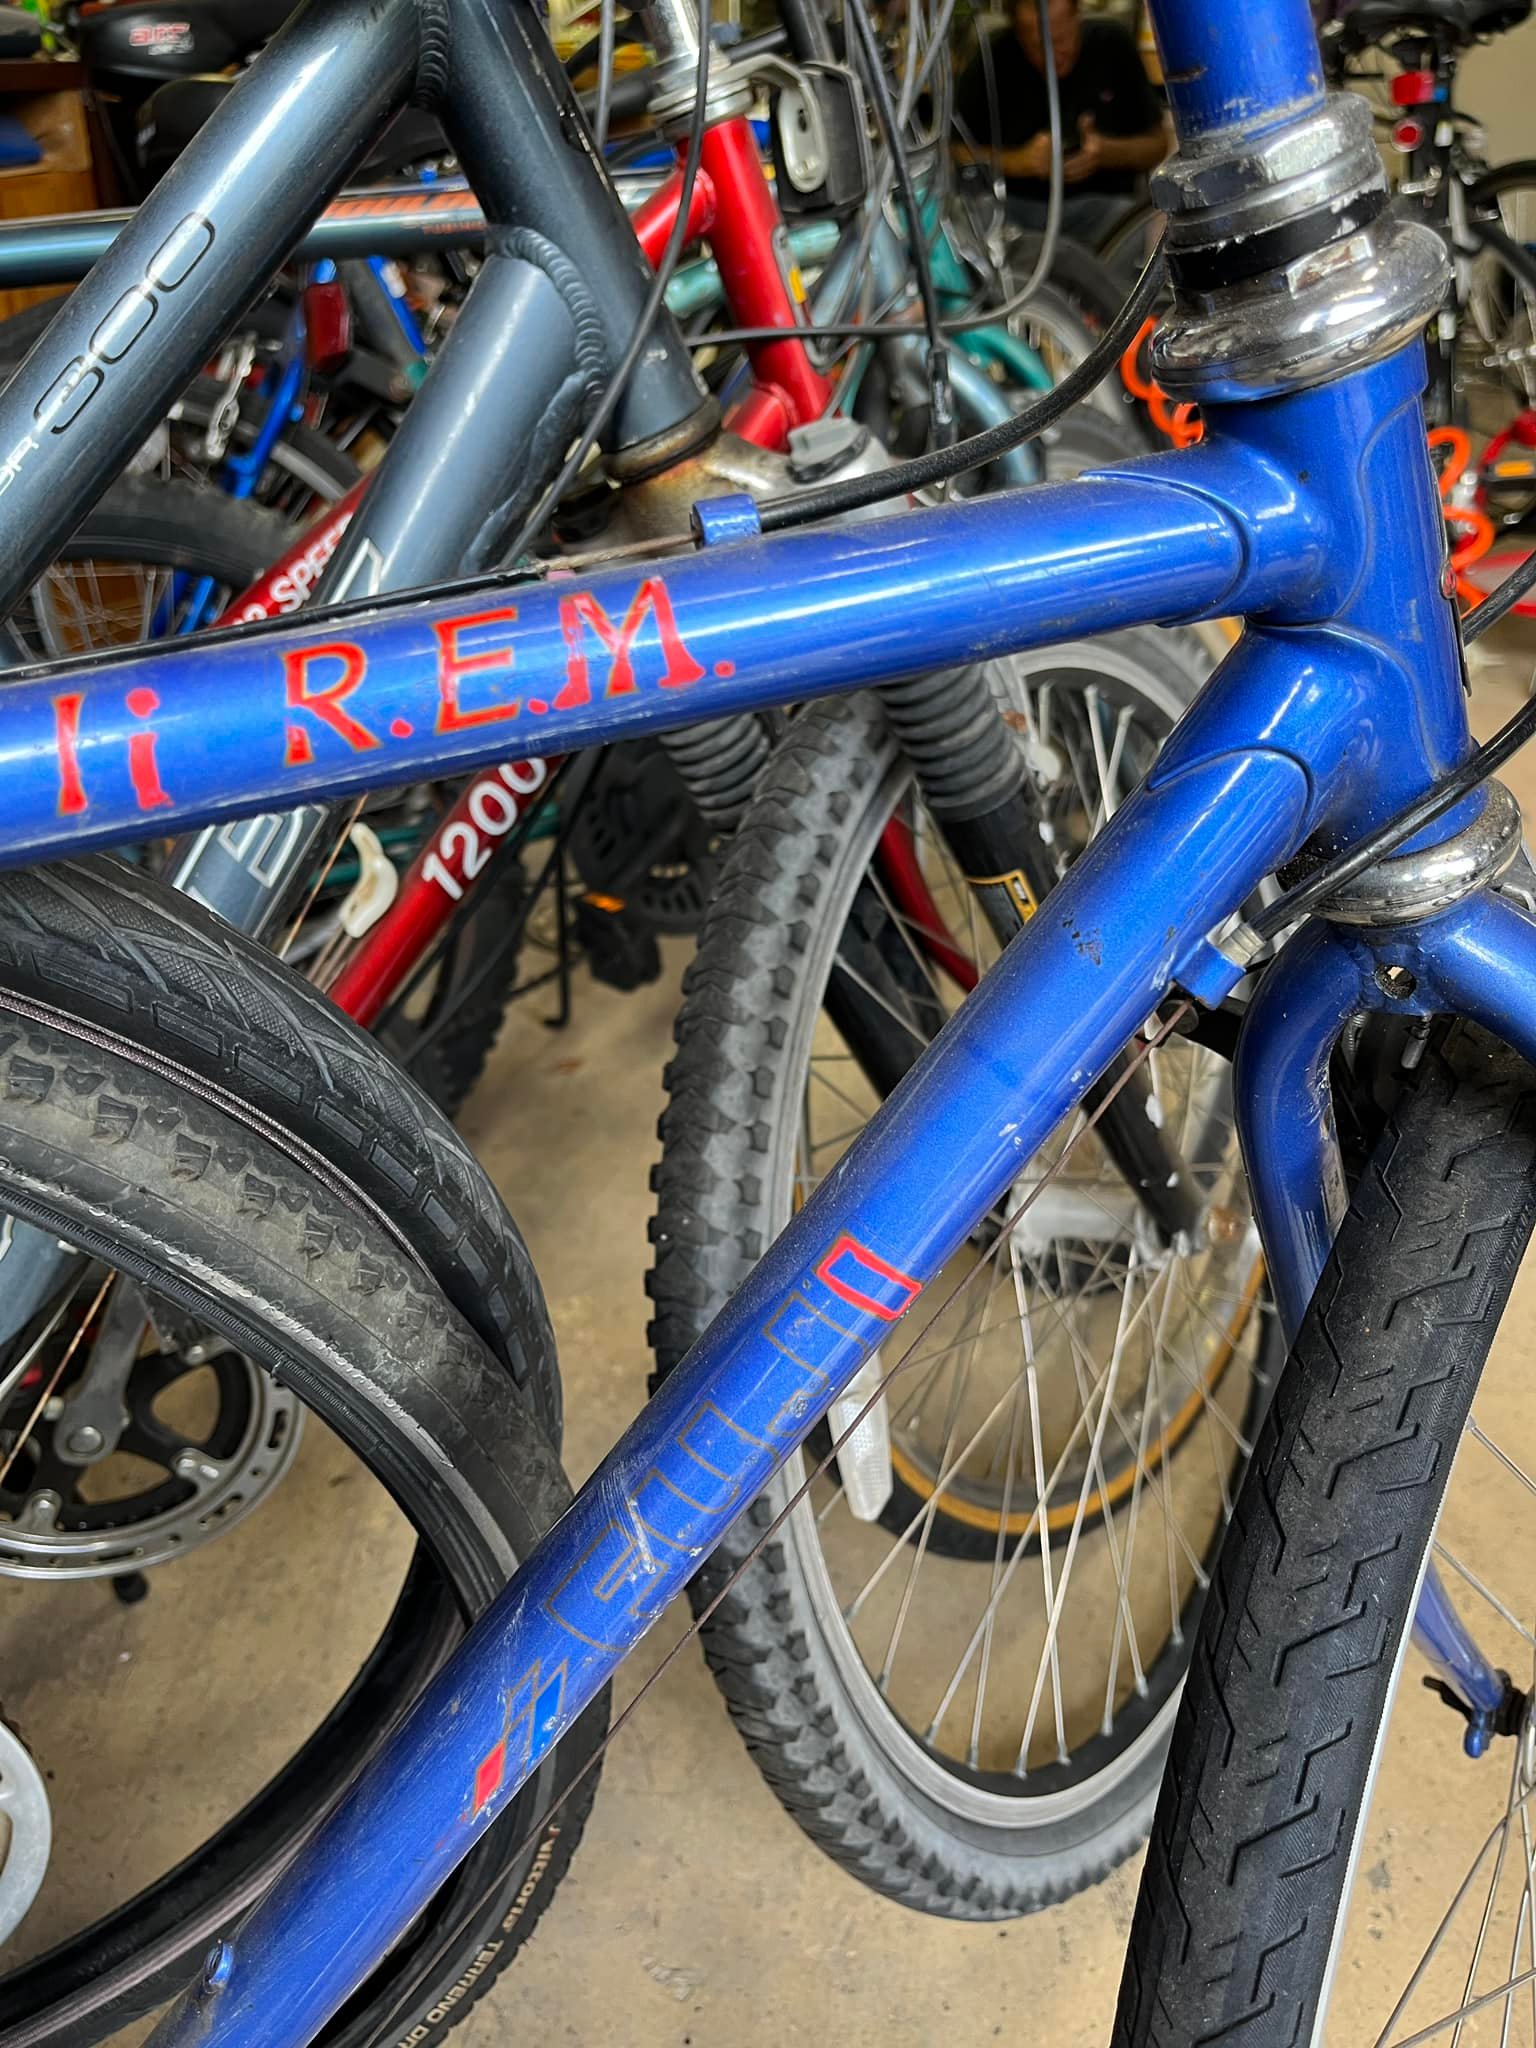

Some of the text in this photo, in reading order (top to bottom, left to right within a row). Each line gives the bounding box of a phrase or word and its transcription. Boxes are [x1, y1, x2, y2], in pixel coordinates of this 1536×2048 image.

[33, 211, 216, 434] 300
[281, 576, 736, 768] R.E.M.
[422, 757, 547, 901] 1200
[545, 1234, 922, 1653] FUJI
[426, 1940, 504, 2024] TERRENO
